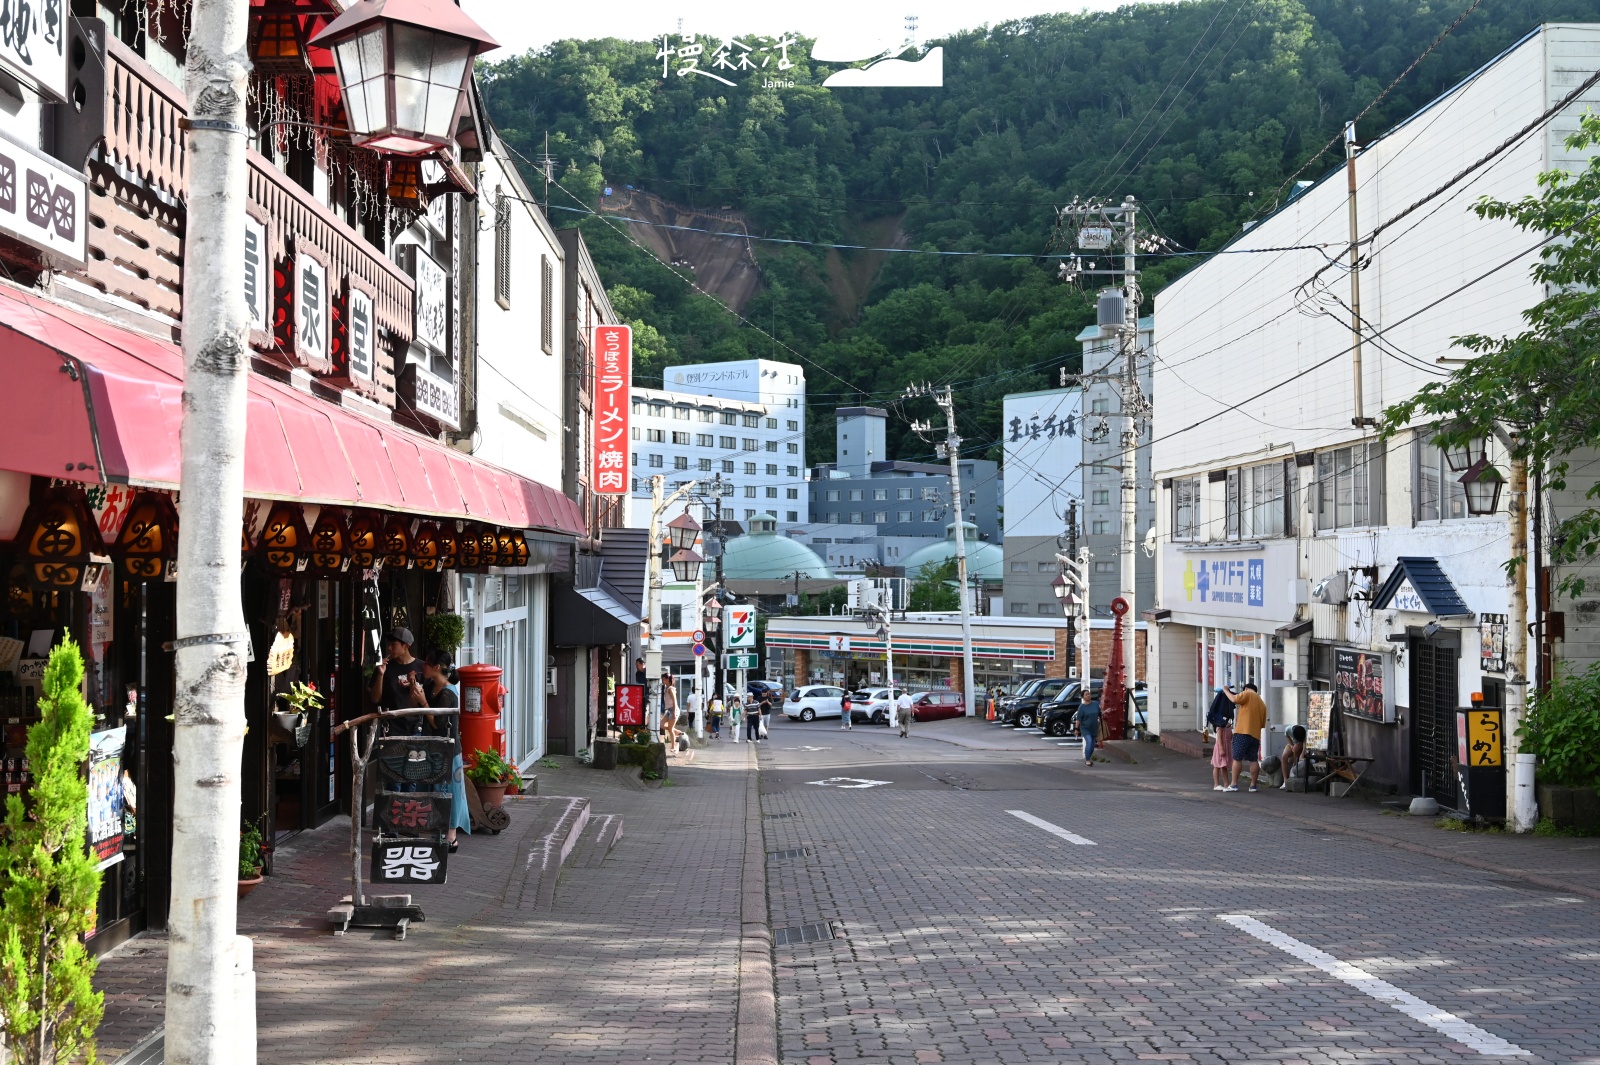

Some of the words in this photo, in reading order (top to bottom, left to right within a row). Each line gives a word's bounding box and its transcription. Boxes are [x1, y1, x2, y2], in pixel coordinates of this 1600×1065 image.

[686, 369, 750, 384] 登別グランドホテル
[598, 330, 624, 489] さっぽろラーメン・焼肉
[1250, 564, 1262, 580] 札幌
[736, 656, 750, 668] 酒
[1472, 713, 1499, 765] らーめん
[391, 800, 432, 828] 染
[382, 846, 440, 881] 器
